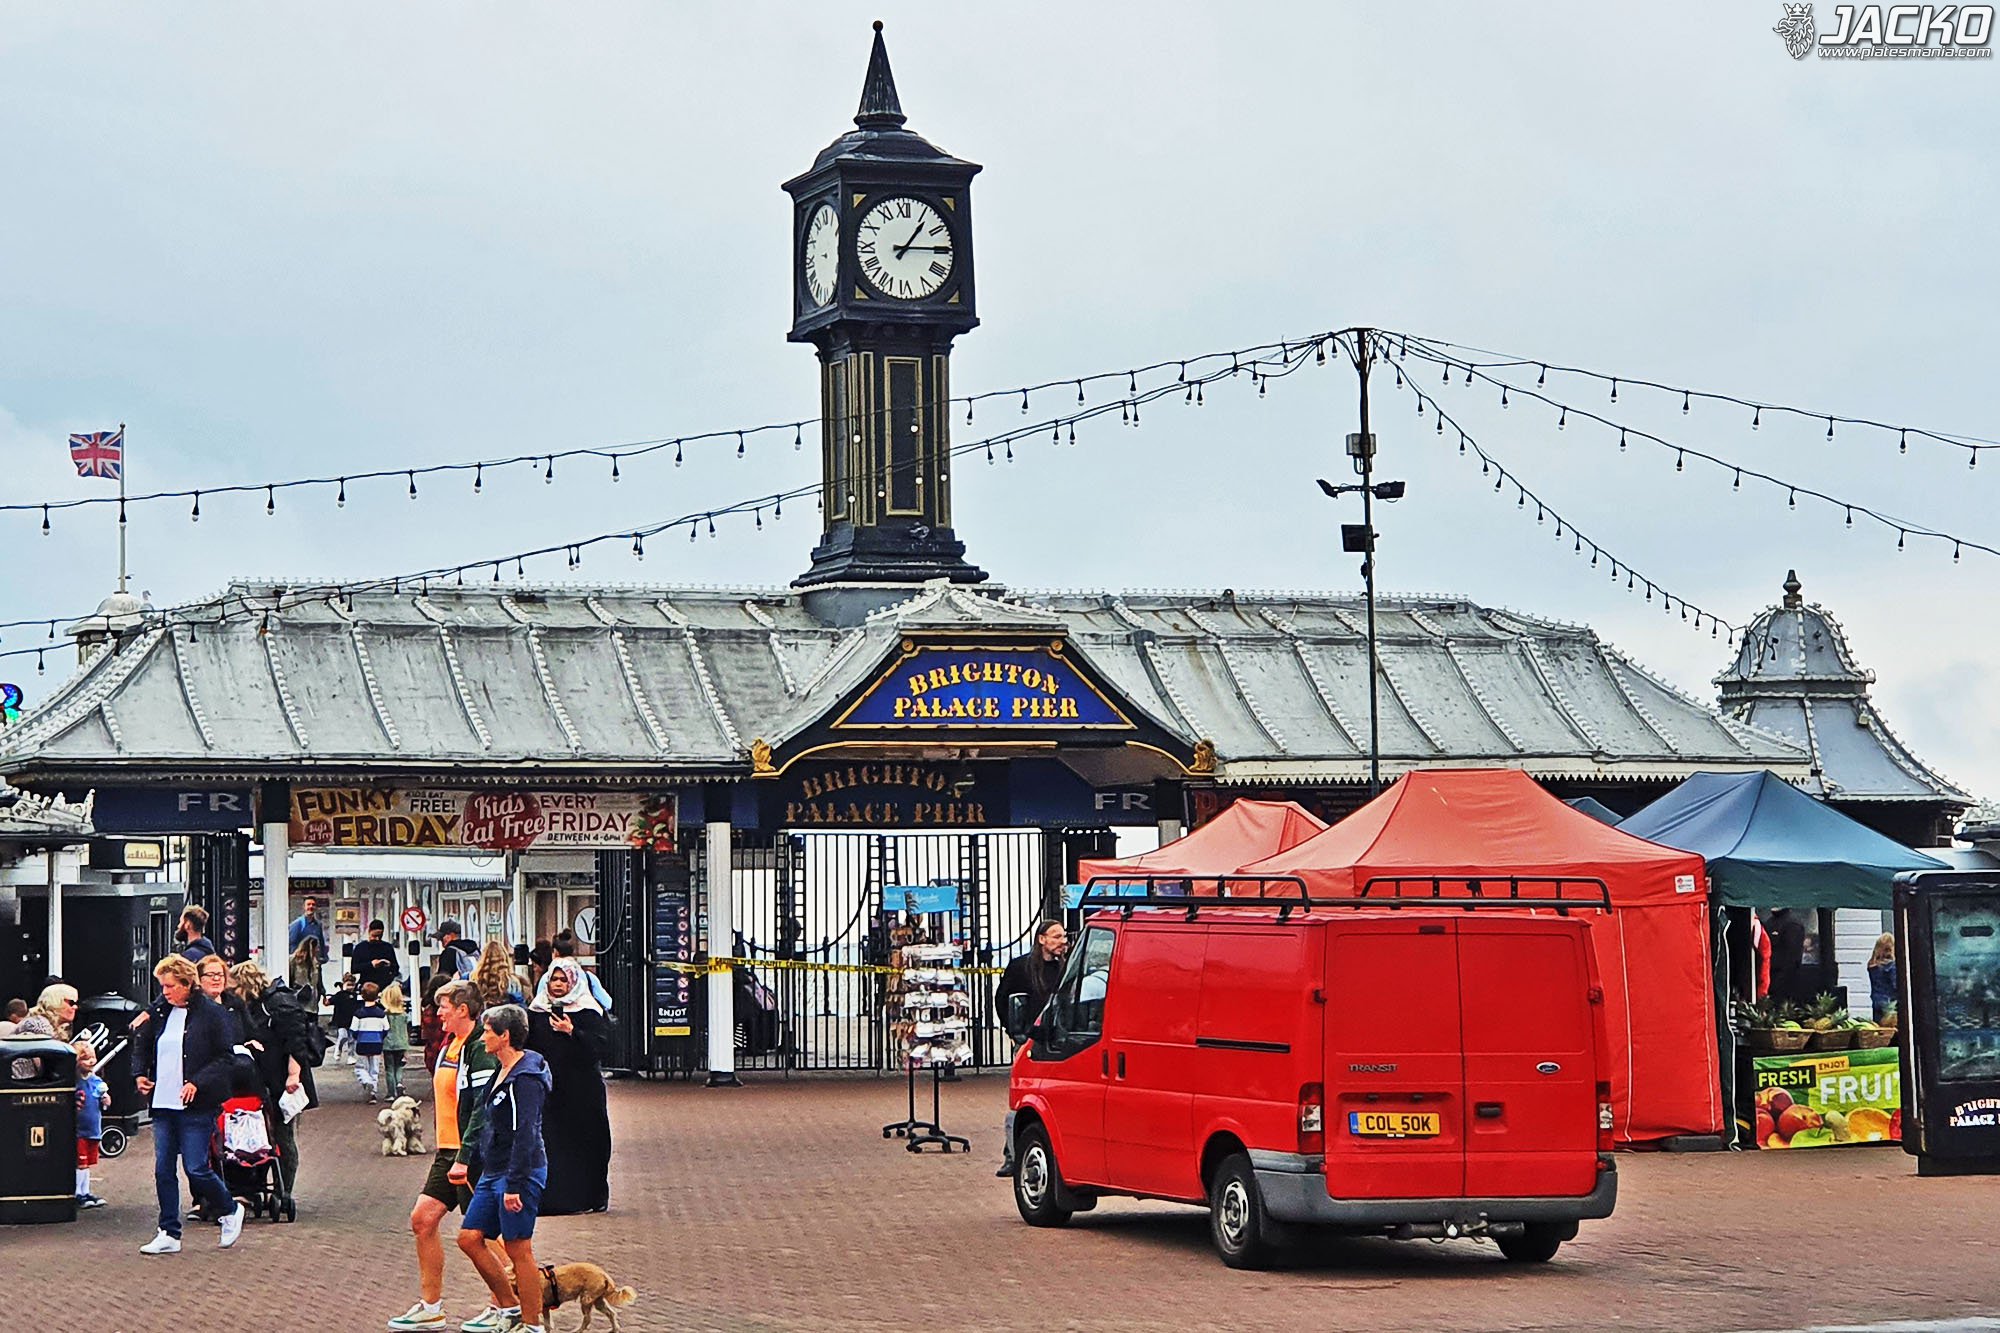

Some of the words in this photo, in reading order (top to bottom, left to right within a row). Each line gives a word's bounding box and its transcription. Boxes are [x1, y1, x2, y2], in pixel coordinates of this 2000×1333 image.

[896, 202, 911, 219] XII
[908, 662, 1060, 697] BRIGHTON
[893, 697, 1000, 718] PALACE
[1012, 697, 1079, 718] PIER
[802, 764, 962, 799] BRIGHTO
[296, 788, 393, 821] FUNKY
[410, 799, 455, 813] FREE!
[474, 795, 526, 820] Kids
[540, 795, 597, 809] EVERY
[548, 812, 632, 832] FRIDAY
[785, 802, 900, 824] PALACE
[913, 802, 986, 824] PIER
[333, 815, 461, 846] FRIDAY
[462, 820, 496, 845] Eat
[500, 815, 545, 839] Free
[547, 833, 591, 841] BETWEEN
[658, 1007, 688, 1017] ENJOY
[1349, 1063, 1398, 1072] TRANSIT
[1818, 1060, 1846, 1071] ENJOY
[1758, 1070, 1811, 1088] FRESH
[1366, 1115, 1397, 1131] COL
[1401, 1115, 1432, 1132] 50K
[1949, 1114, 1996, 1127] PALACE
